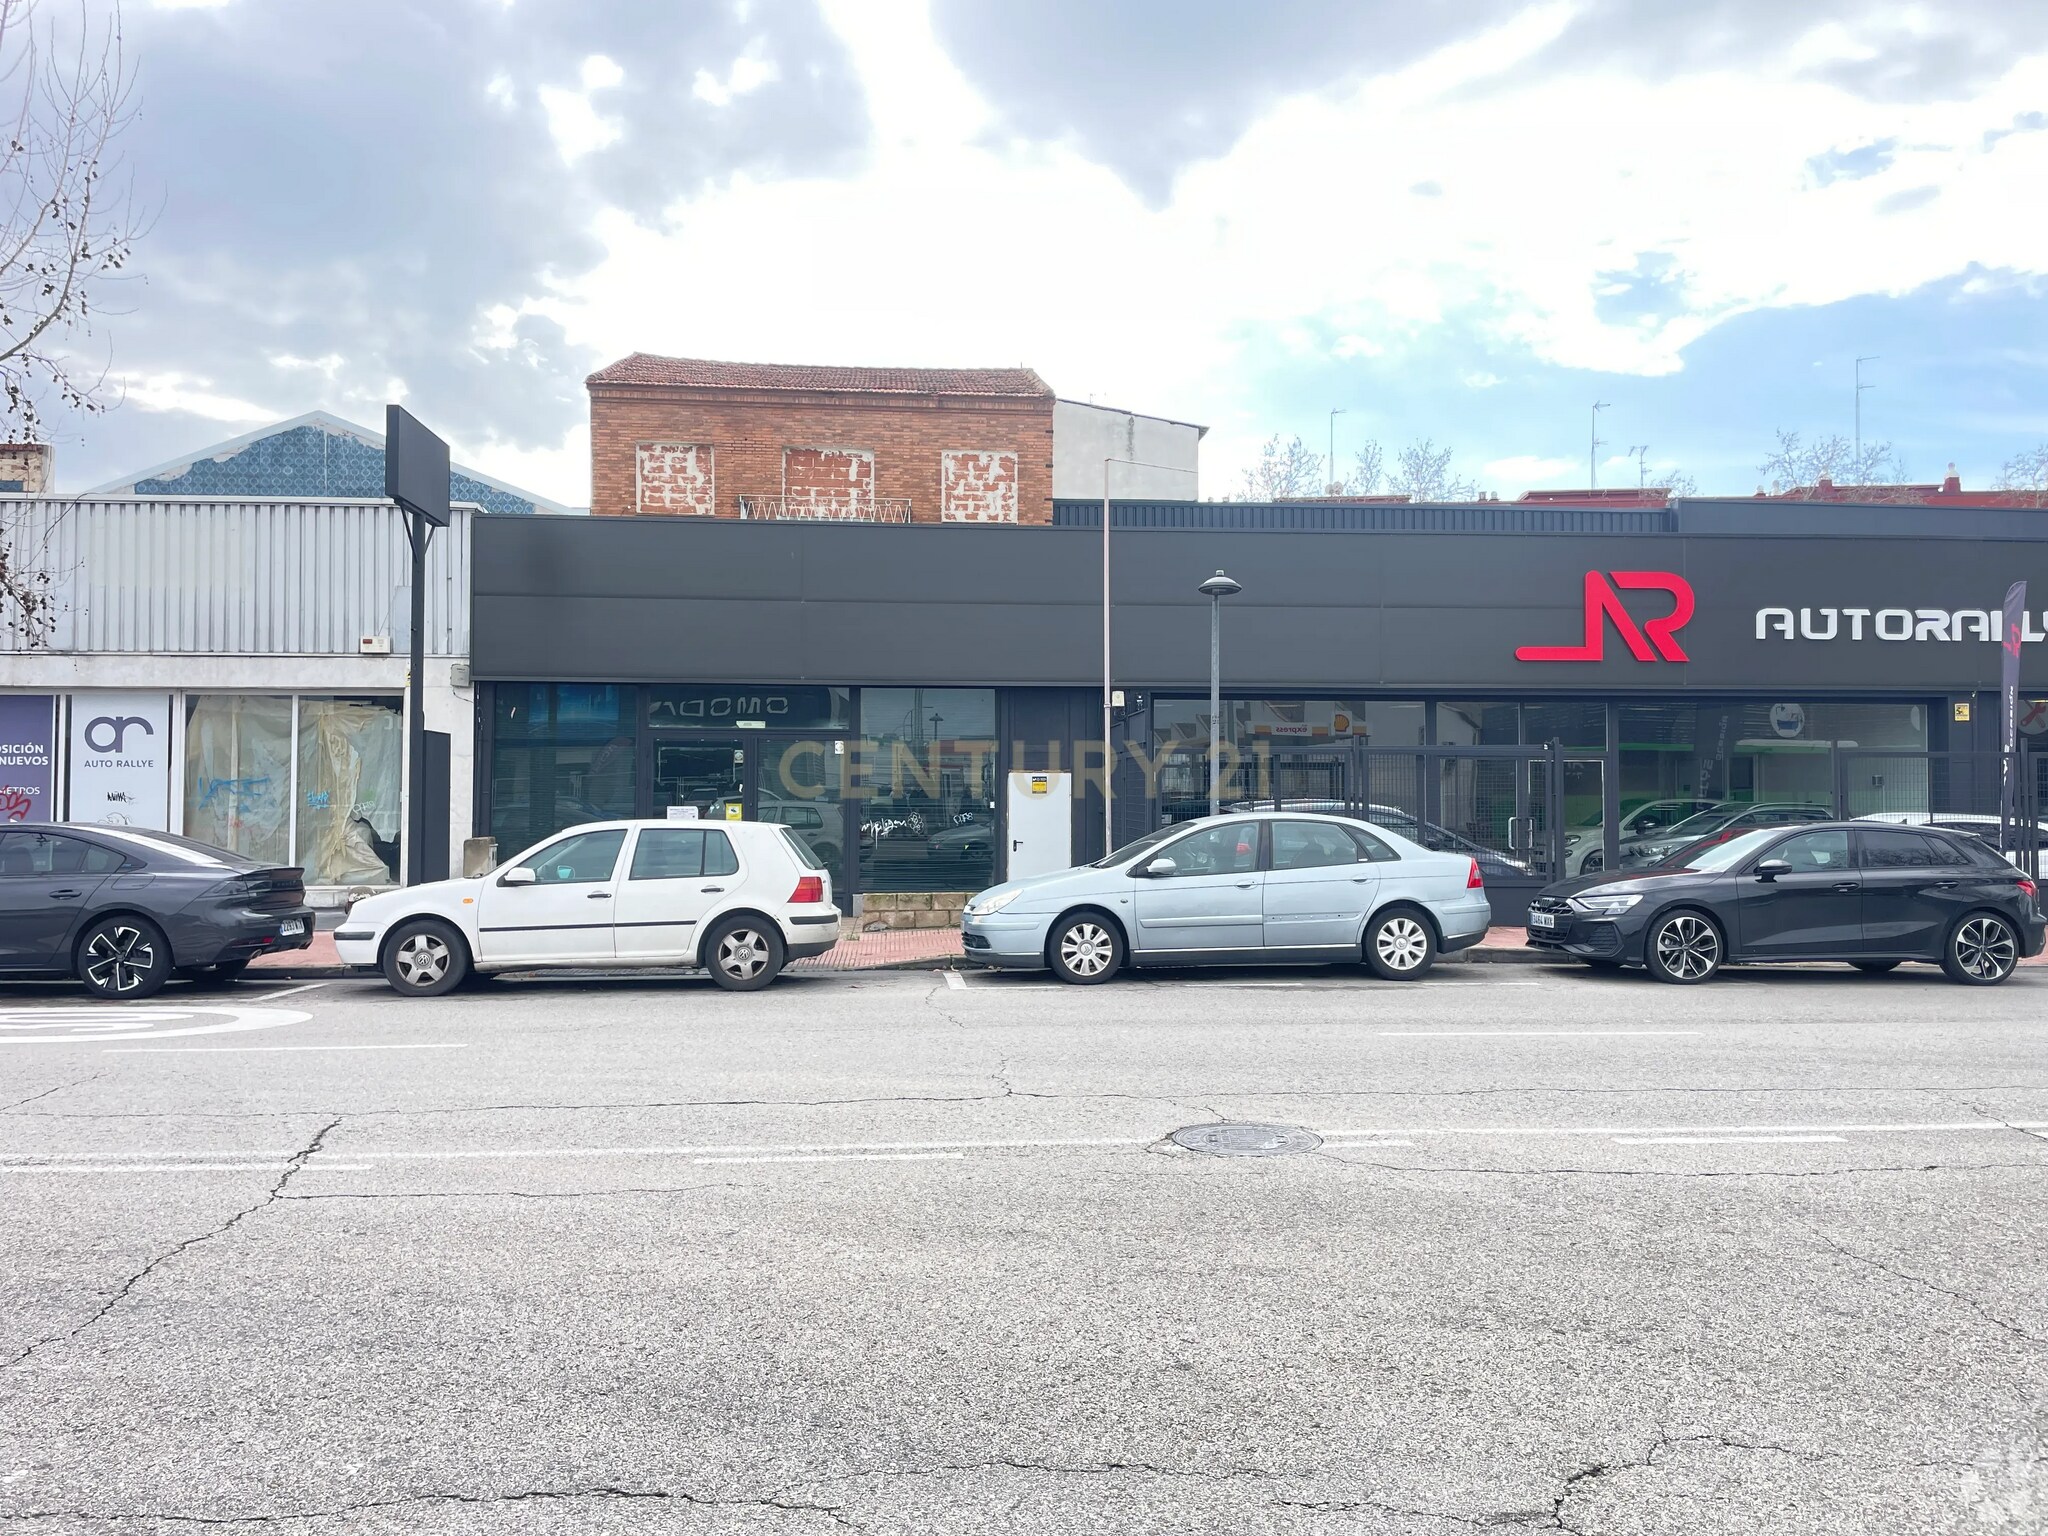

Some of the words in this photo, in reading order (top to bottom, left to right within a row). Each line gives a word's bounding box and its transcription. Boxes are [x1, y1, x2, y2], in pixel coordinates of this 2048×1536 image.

[1755, 607, 2048, 642] AUTORALL
[0, 742, 44, 754] SICIÓN
[0, 756, 49, 766] NUEVOS
[84, 760, 113, 768] AUTO
[117, 760, 154, 768] RALLYE
